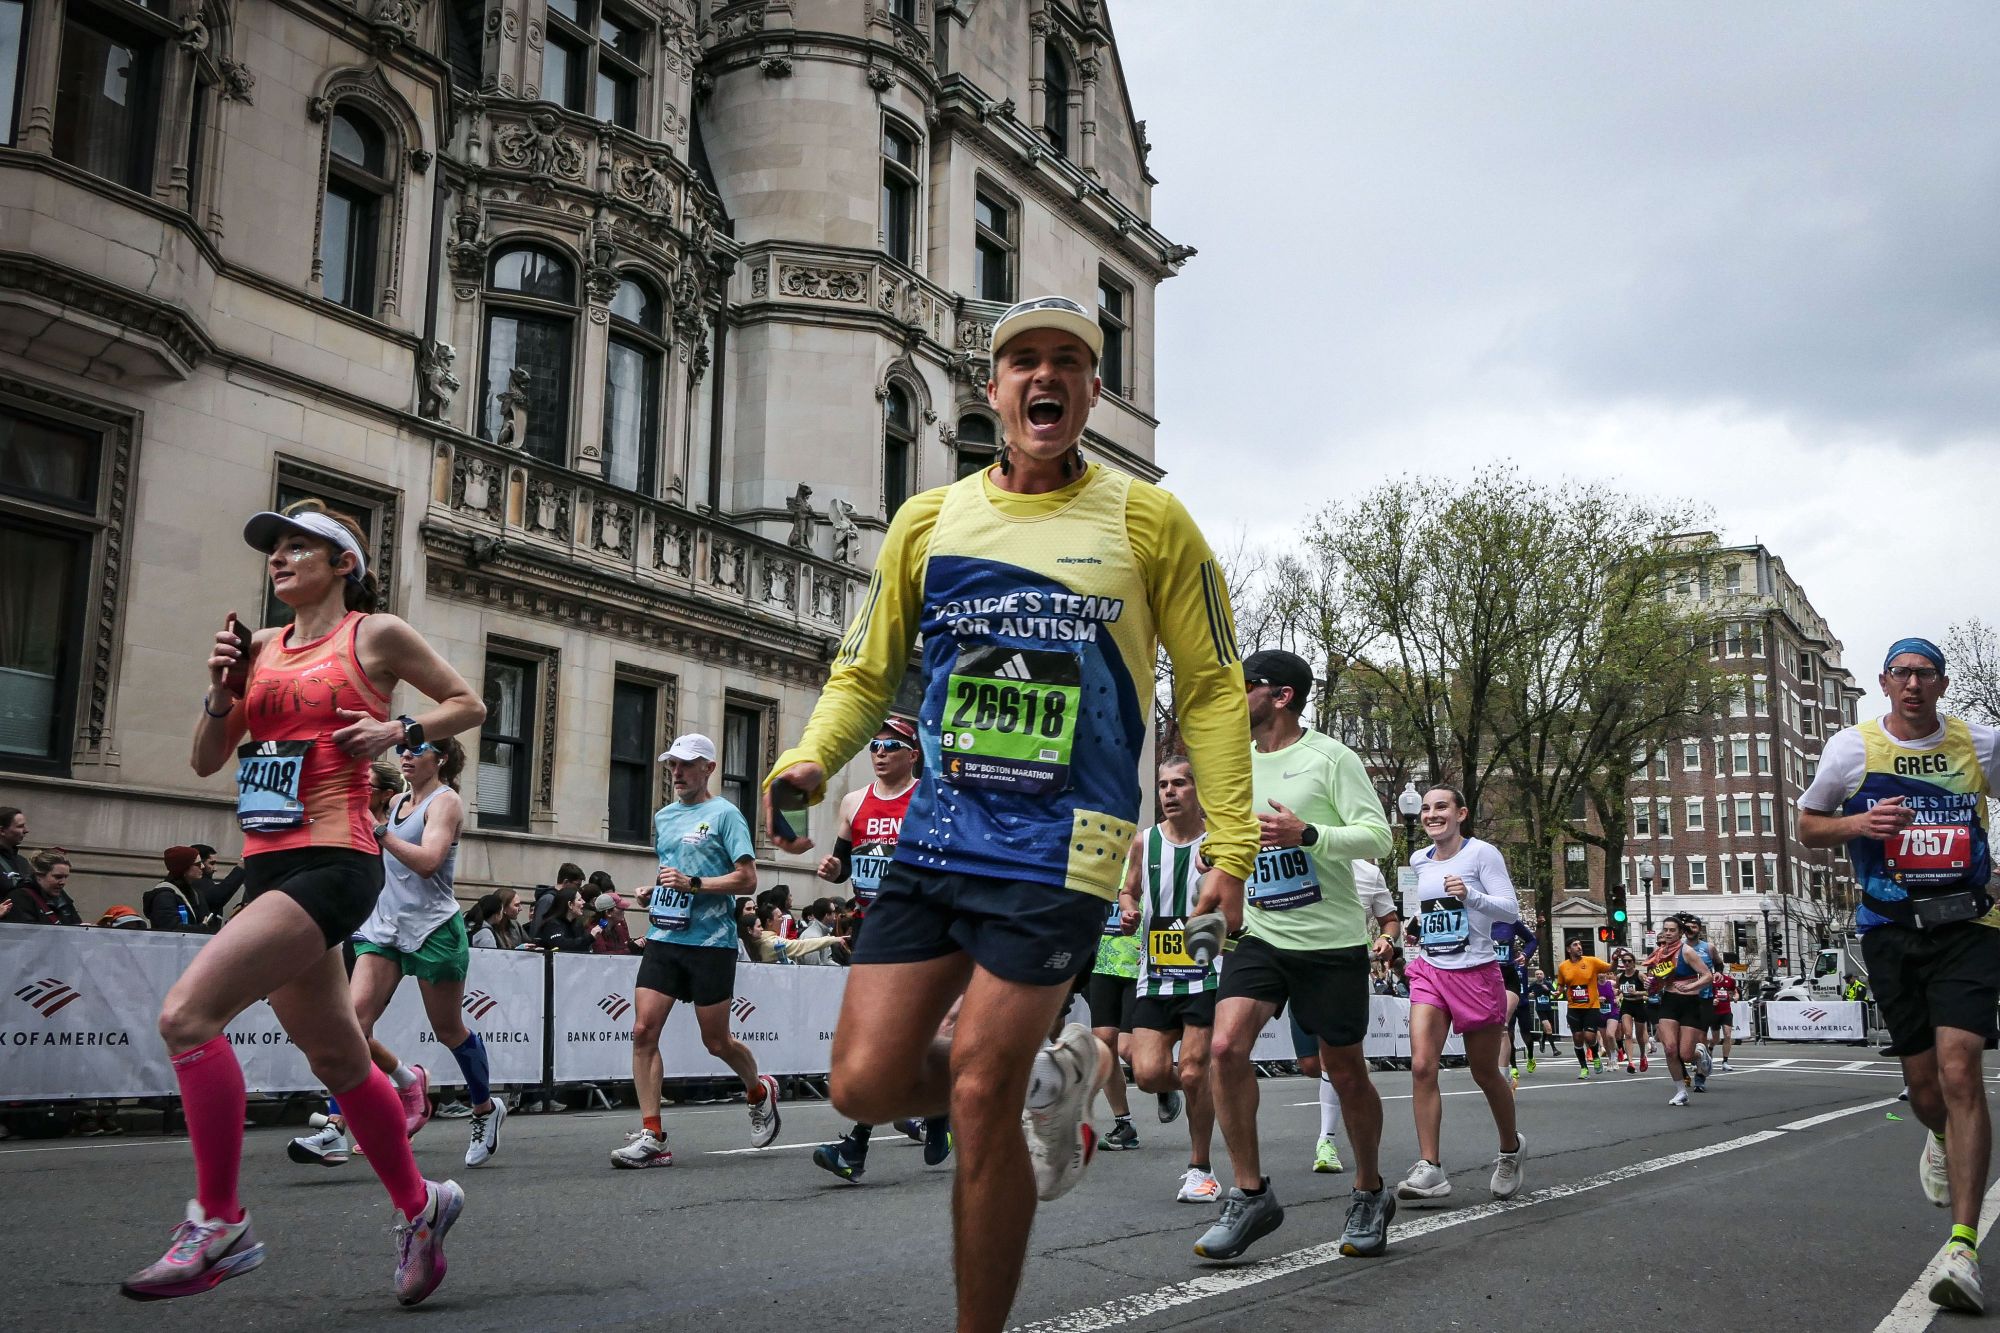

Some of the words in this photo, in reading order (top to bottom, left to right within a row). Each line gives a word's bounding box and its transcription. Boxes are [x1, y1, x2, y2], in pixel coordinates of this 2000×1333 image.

[1050, 592, 1124, 623] TEAM
[997, 616, 1098, 643] AUTISM
[951, 681, 1067, 739] 26618
[942, 732, 954, 747] 8
[981, 764, 1011, 775] BOSTON
[1012, 768, 1054, 781] MARATHON
[1893, 753, 1948, 776] GREG
[1913, 808, 1972, 823] AUTISM
[866, 817, 903, 836] BEN
[1899, 828, 1955, 856] 7857
[653, 887, 689, 909] 14675
[1423, 911, 1462, 935] 15917
[1154, 933, 1186, 955] 163
[13, 1032, 39, 1046] OF
[43, 1031, 130, 1046] AMERICA
[225, 1032, 257, 1045] ANK
[262, 1032, 281, 1045] OF
[477, 1032, 530, 1043] AMERICA
[567, 1031, 596, 1042] BANK
[598, 1031, 613, 1041] OF
[742, 1032, 779, 1041] AMERICA
[819, 1031, 835, 1040] BAN
